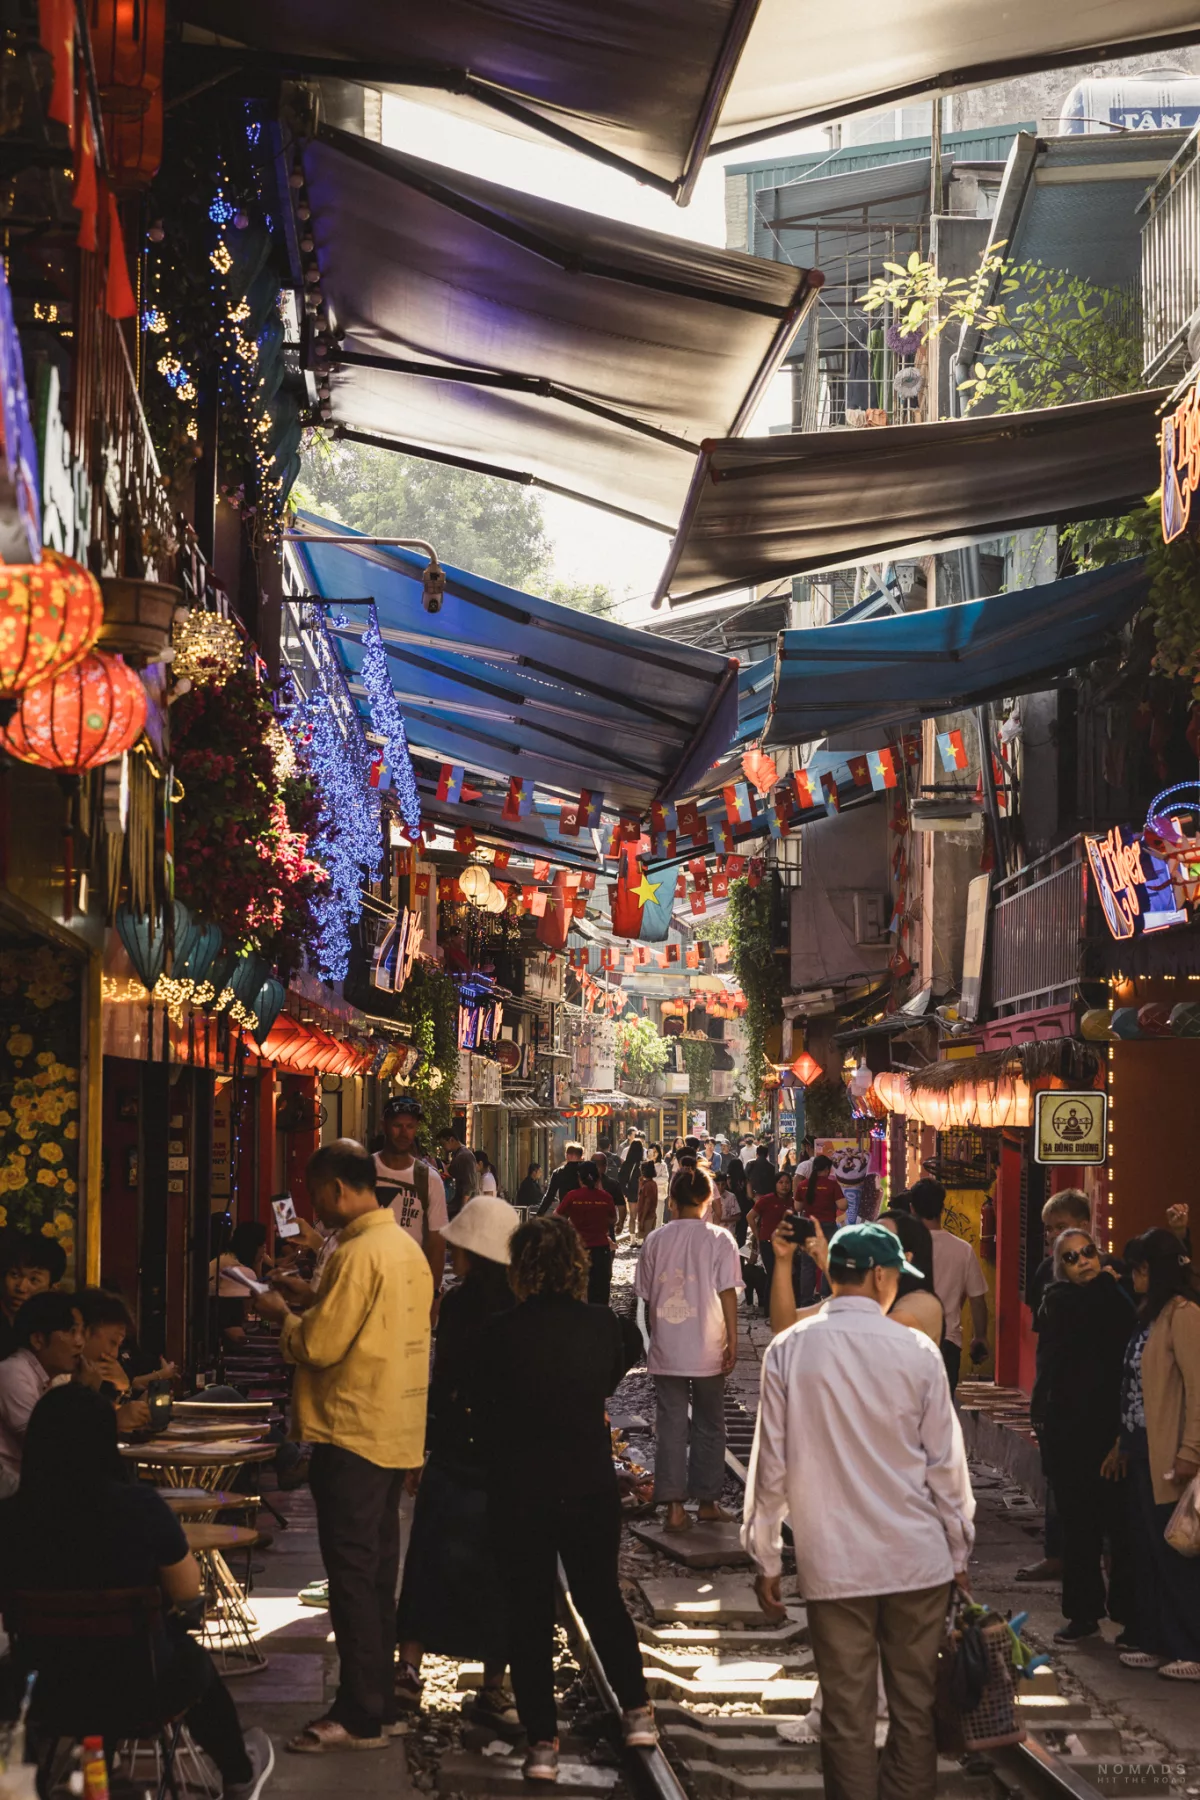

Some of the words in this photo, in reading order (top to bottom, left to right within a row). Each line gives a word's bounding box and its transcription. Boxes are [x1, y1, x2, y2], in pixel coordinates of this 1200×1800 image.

[1119, 110, 1182, 131] TÂN
[1100, 826, 1146, 916] Tiger
[1043, 1143, 1052, 1152] GA
[403, 1197, 414, 1207] UP
[402, 1207, 419, 1219] BIKE
[400, 1217, 412, 1228] CO.
